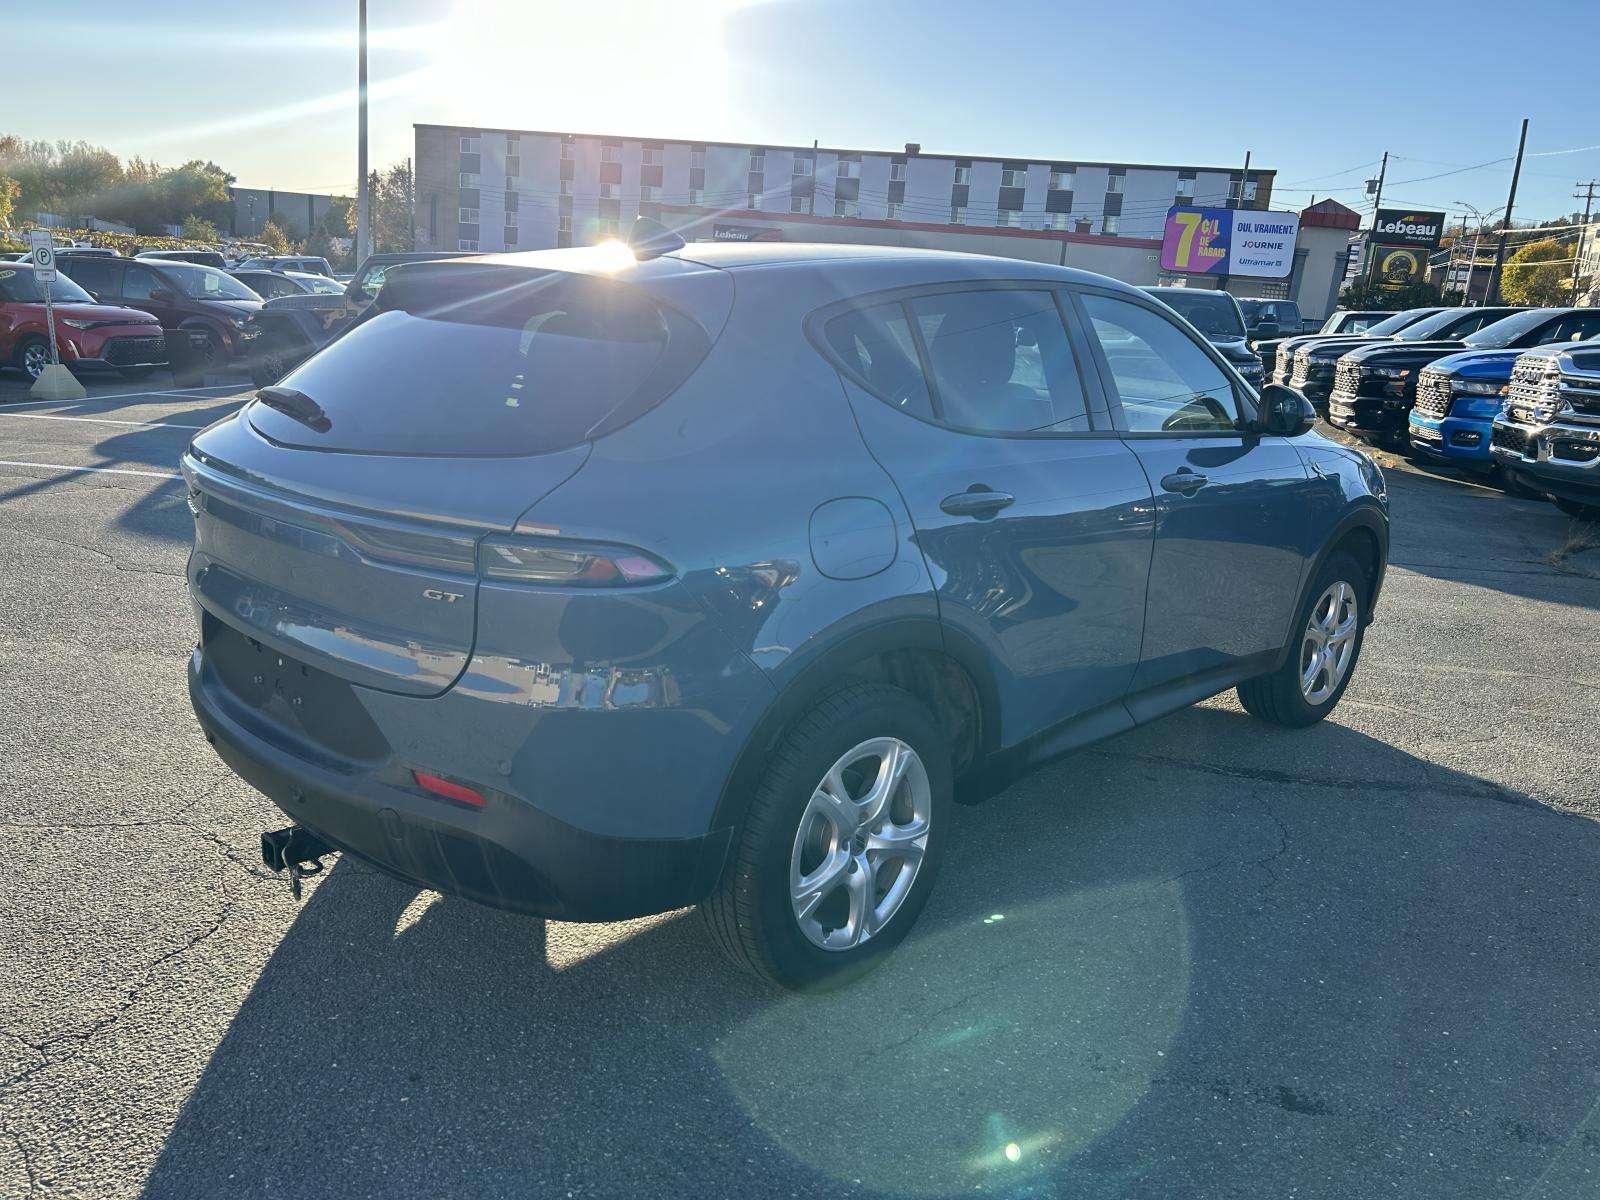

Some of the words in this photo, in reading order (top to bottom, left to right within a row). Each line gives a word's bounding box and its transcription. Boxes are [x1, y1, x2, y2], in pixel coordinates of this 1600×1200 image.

[1254, 223, 1294, 235] VRAIMENT.
[1377, 219, 1437, 236] Lebeau
[714, 230, 749, 240] Lebeau
[1175, 212, 1202, 267] 7
[1200, 236, 1210, 247] DE
[1241, 240, 1283, 250] JOURNIE
[1197, 247, 1226, 258] RABAIS
[1239, 258, 1275, 267] Ultramar
[422, 589, 465, 603] GT
